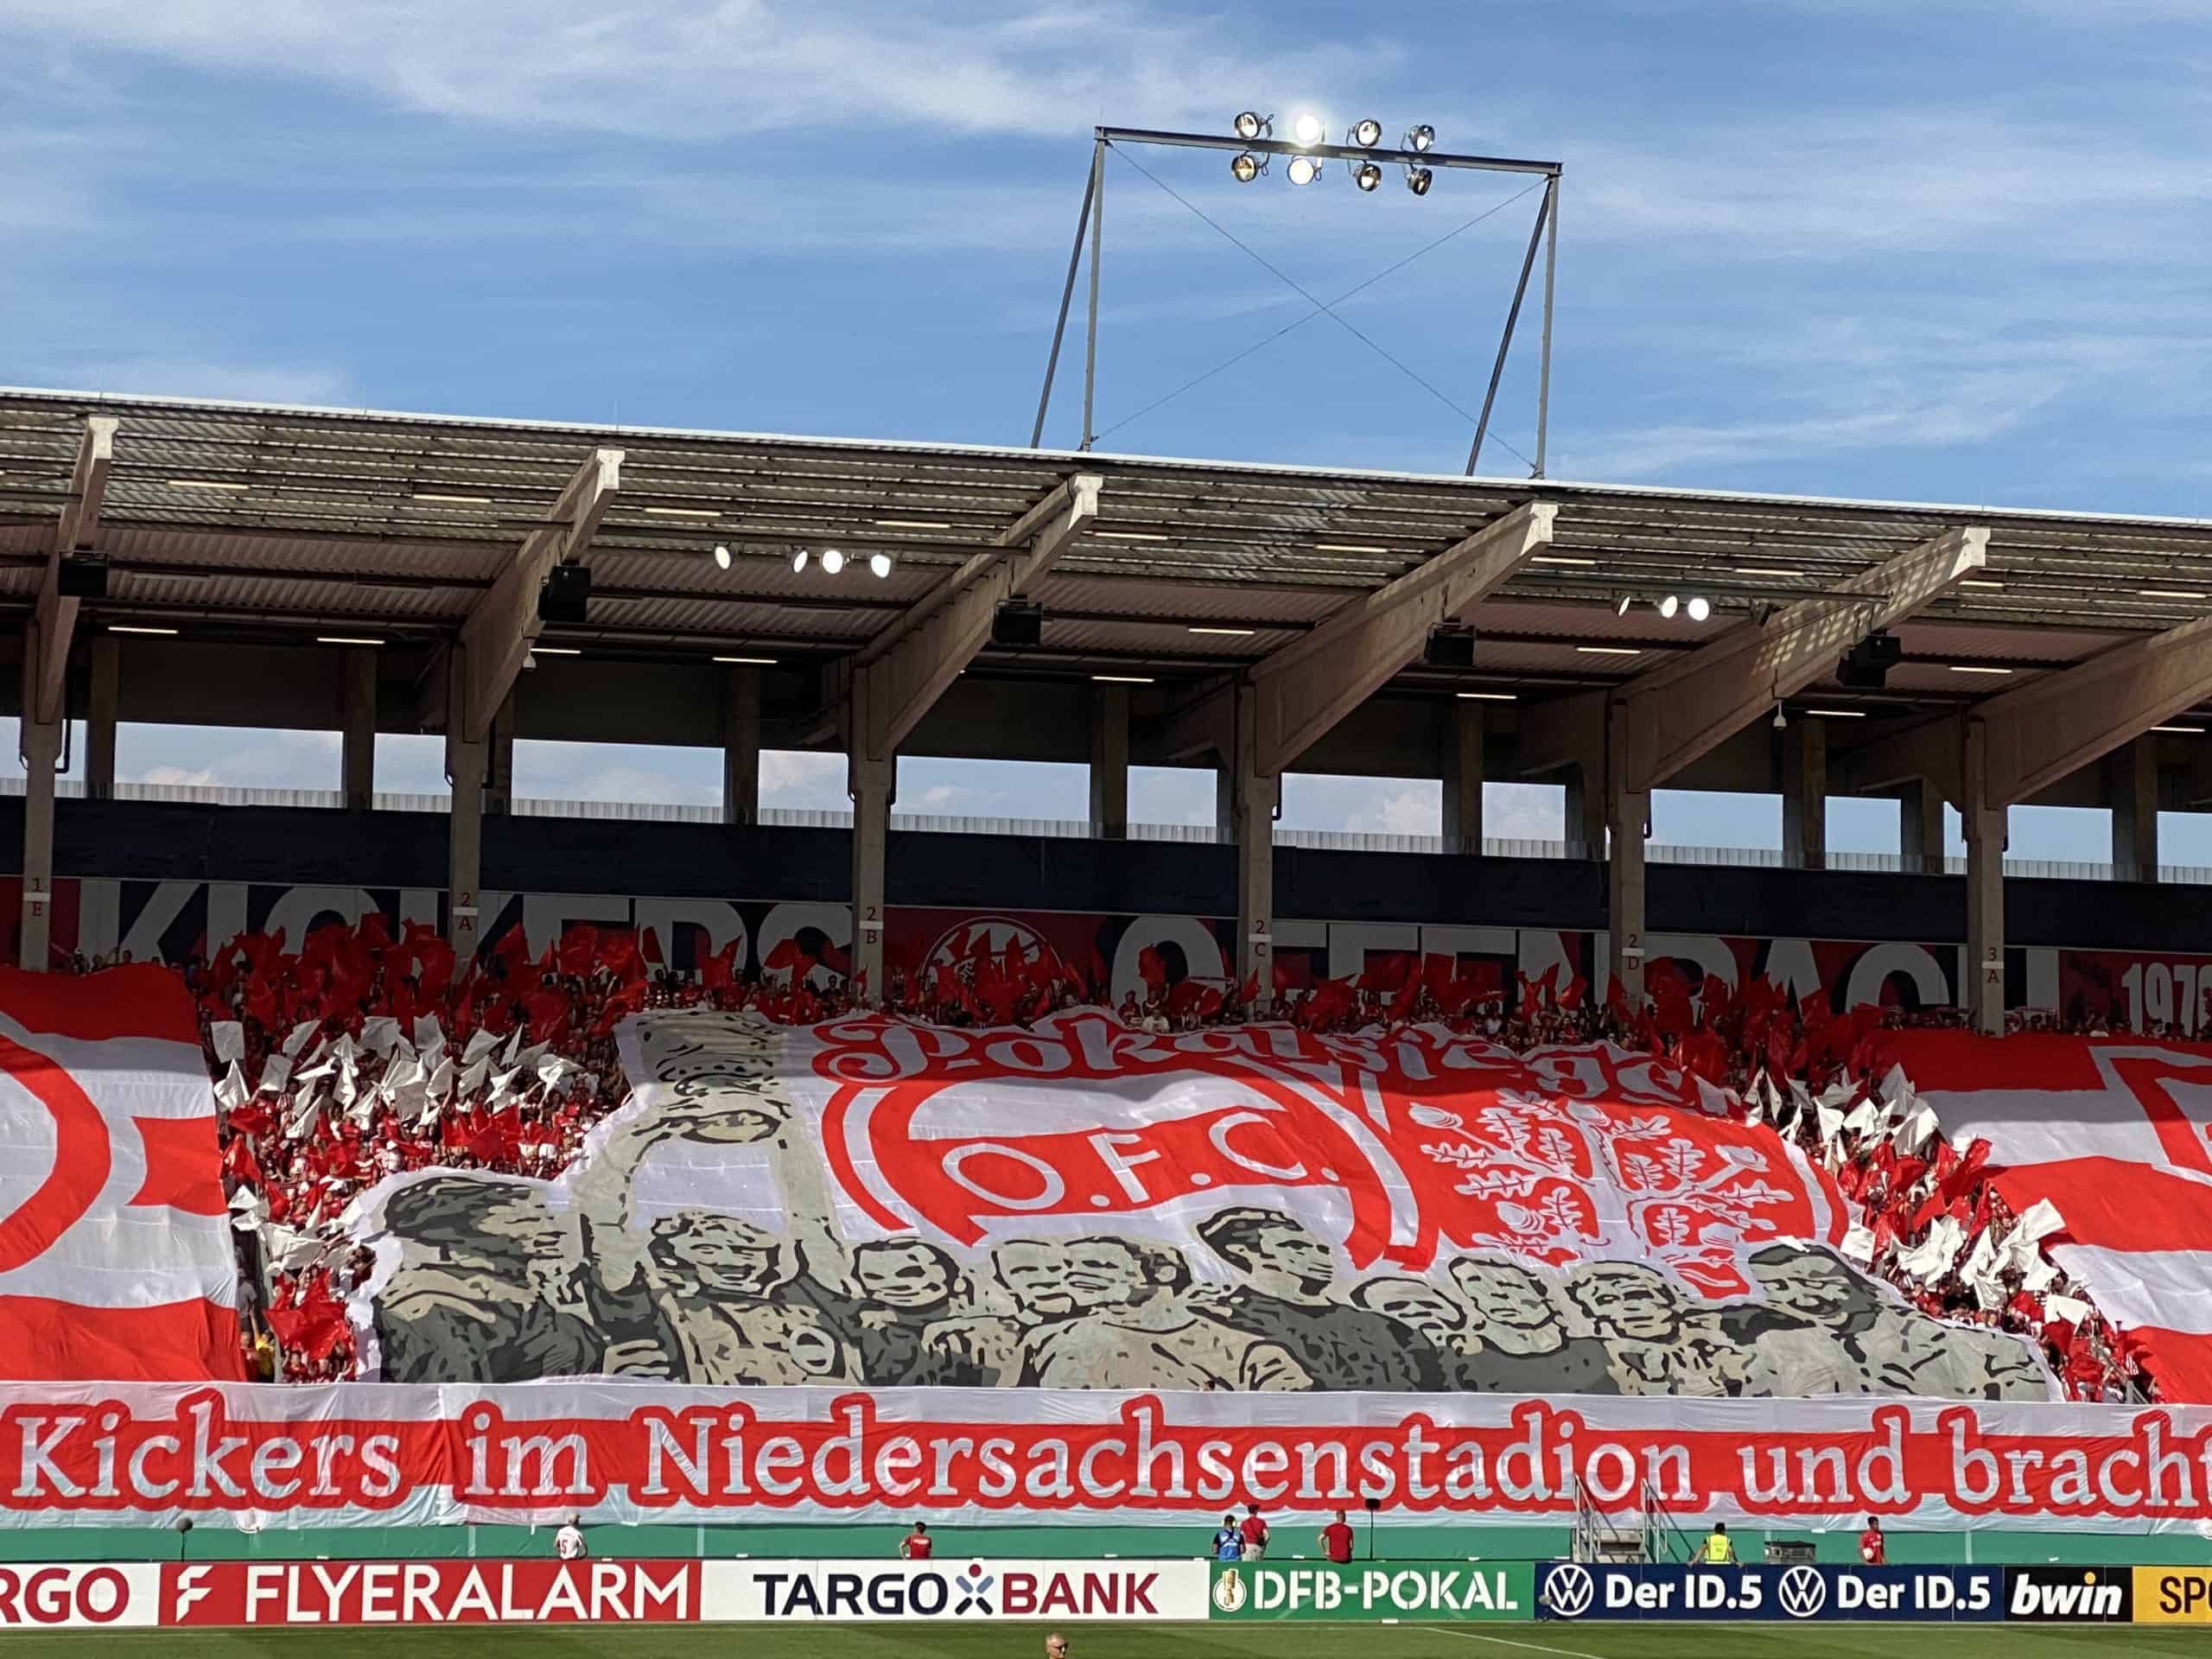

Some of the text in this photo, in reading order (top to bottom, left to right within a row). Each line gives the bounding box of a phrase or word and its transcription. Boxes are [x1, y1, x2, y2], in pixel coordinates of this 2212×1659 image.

[461, 892, 471, 906] 2
[32, 901, 42, 917] E
[867, 906, 876, 921] 2
[459, 916, 473, 931] A
[1255, 919, 1265, 934] 2
[867, 930, 877, 944] B
[1629, 934, 1638, 948] 2
[1255, 942, 1265, 957] C
[1988, 947, 1997, 961] 3
[1628, 956, 1639, 969] D
[1986, 969, 1999, 983] A
[10, 1400, 403, 1498] Kickers
[464, 1413, 595, 1496] im
[640, 1404, 1698, 1503] Niedersachsenstadion
[1737, 1415, 1910, 1505] und
[245, 1564, 689, 1623] FLYERALARM
[1254, 1570, 1518, 1611] DFB-POKAL
[1605, 1573, 1675, 1609] Der
[1685, 1573, 1762, 1610] ID.5
[1838, 1575, 1906, 1610] Der
[1915, 1576, 1990, 1610] ID.5
[2011, 1571, 2123, 1616] bwin
[2159, 1575, 2212, 1614] SP
